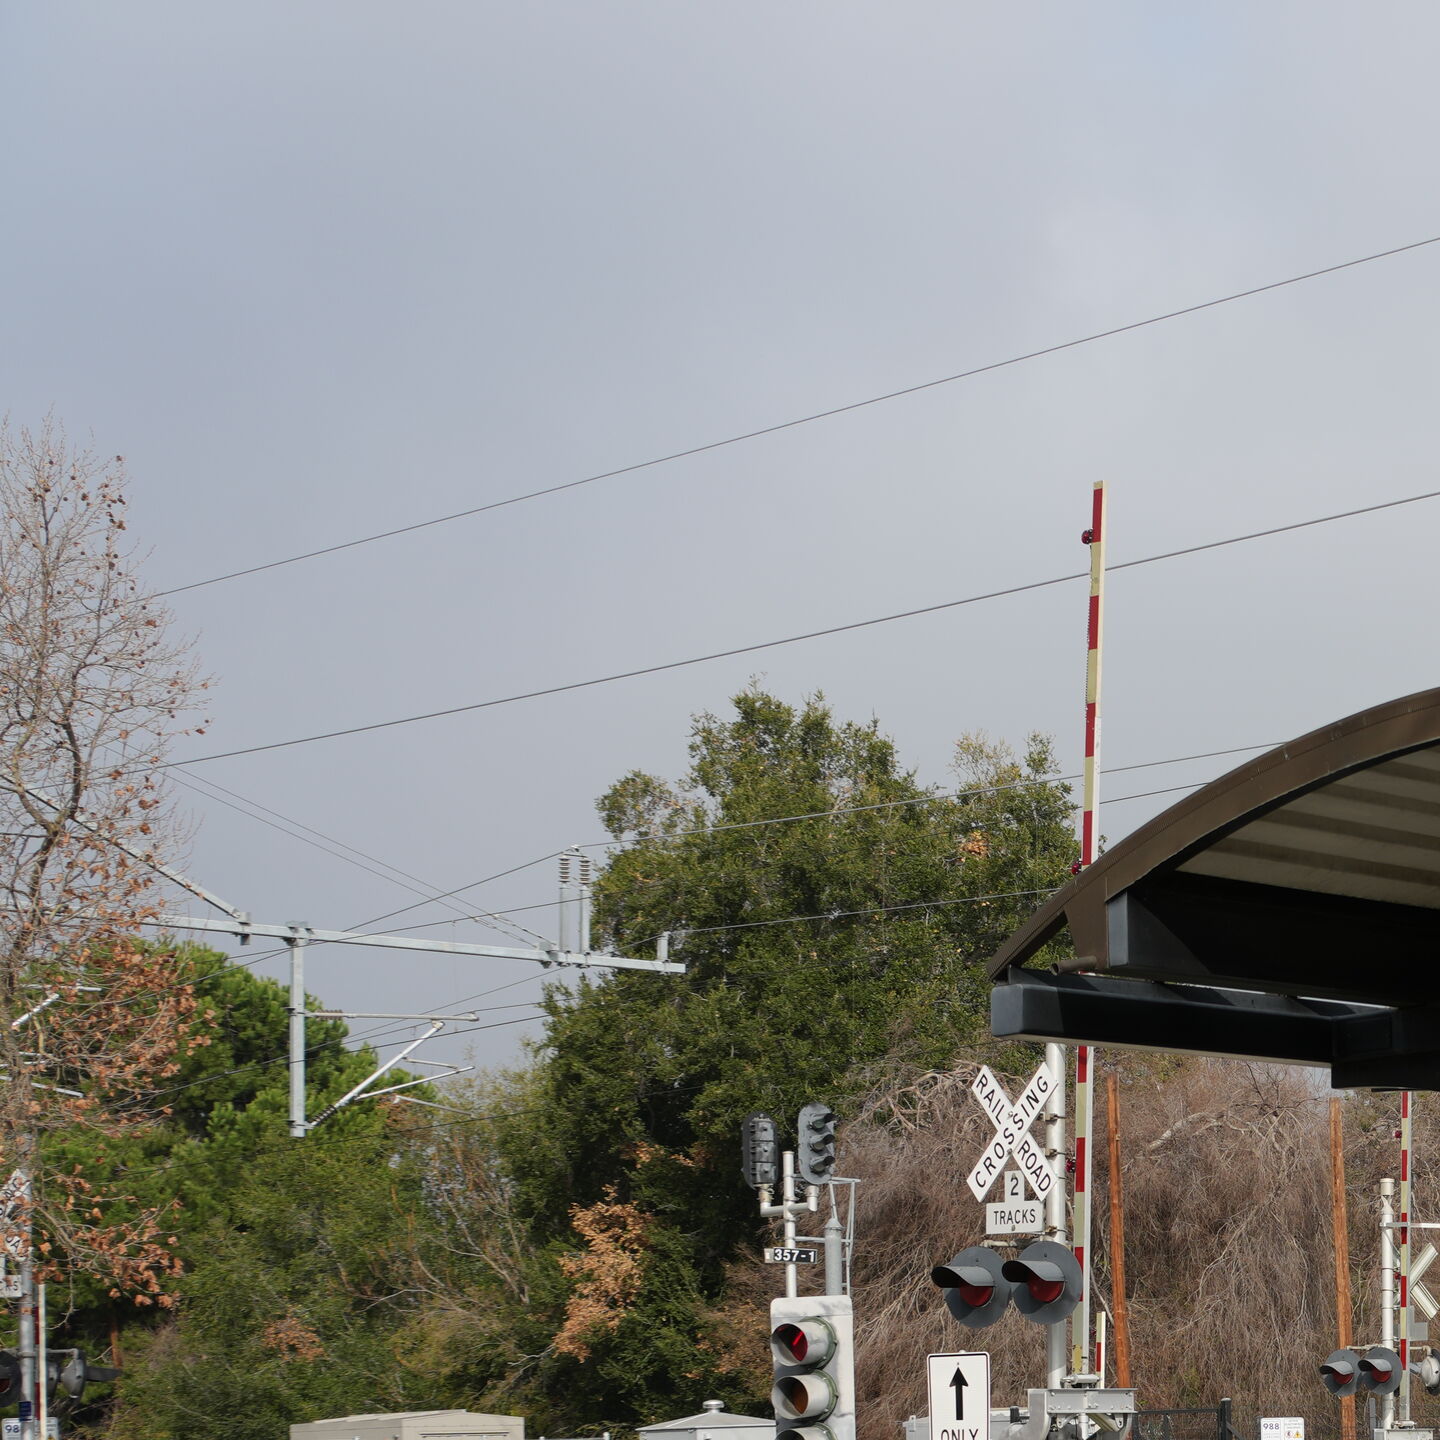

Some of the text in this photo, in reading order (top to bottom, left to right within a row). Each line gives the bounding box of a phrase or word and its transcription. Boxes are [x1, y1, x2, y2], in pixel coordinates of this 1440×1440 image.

[976, 1074, 1005, 1125] RAIL
[975, 1076, 1049, 1189] CROSSING
[1017, 1140, 1051, 1193] ROAD
[1010, 1177, 1019, 1196] 2
[993, 1208, 1036, 1225] TRACKS
[774, 1248, 815, 1263] 357-1
[5, 1424, 20, 1433] 98
